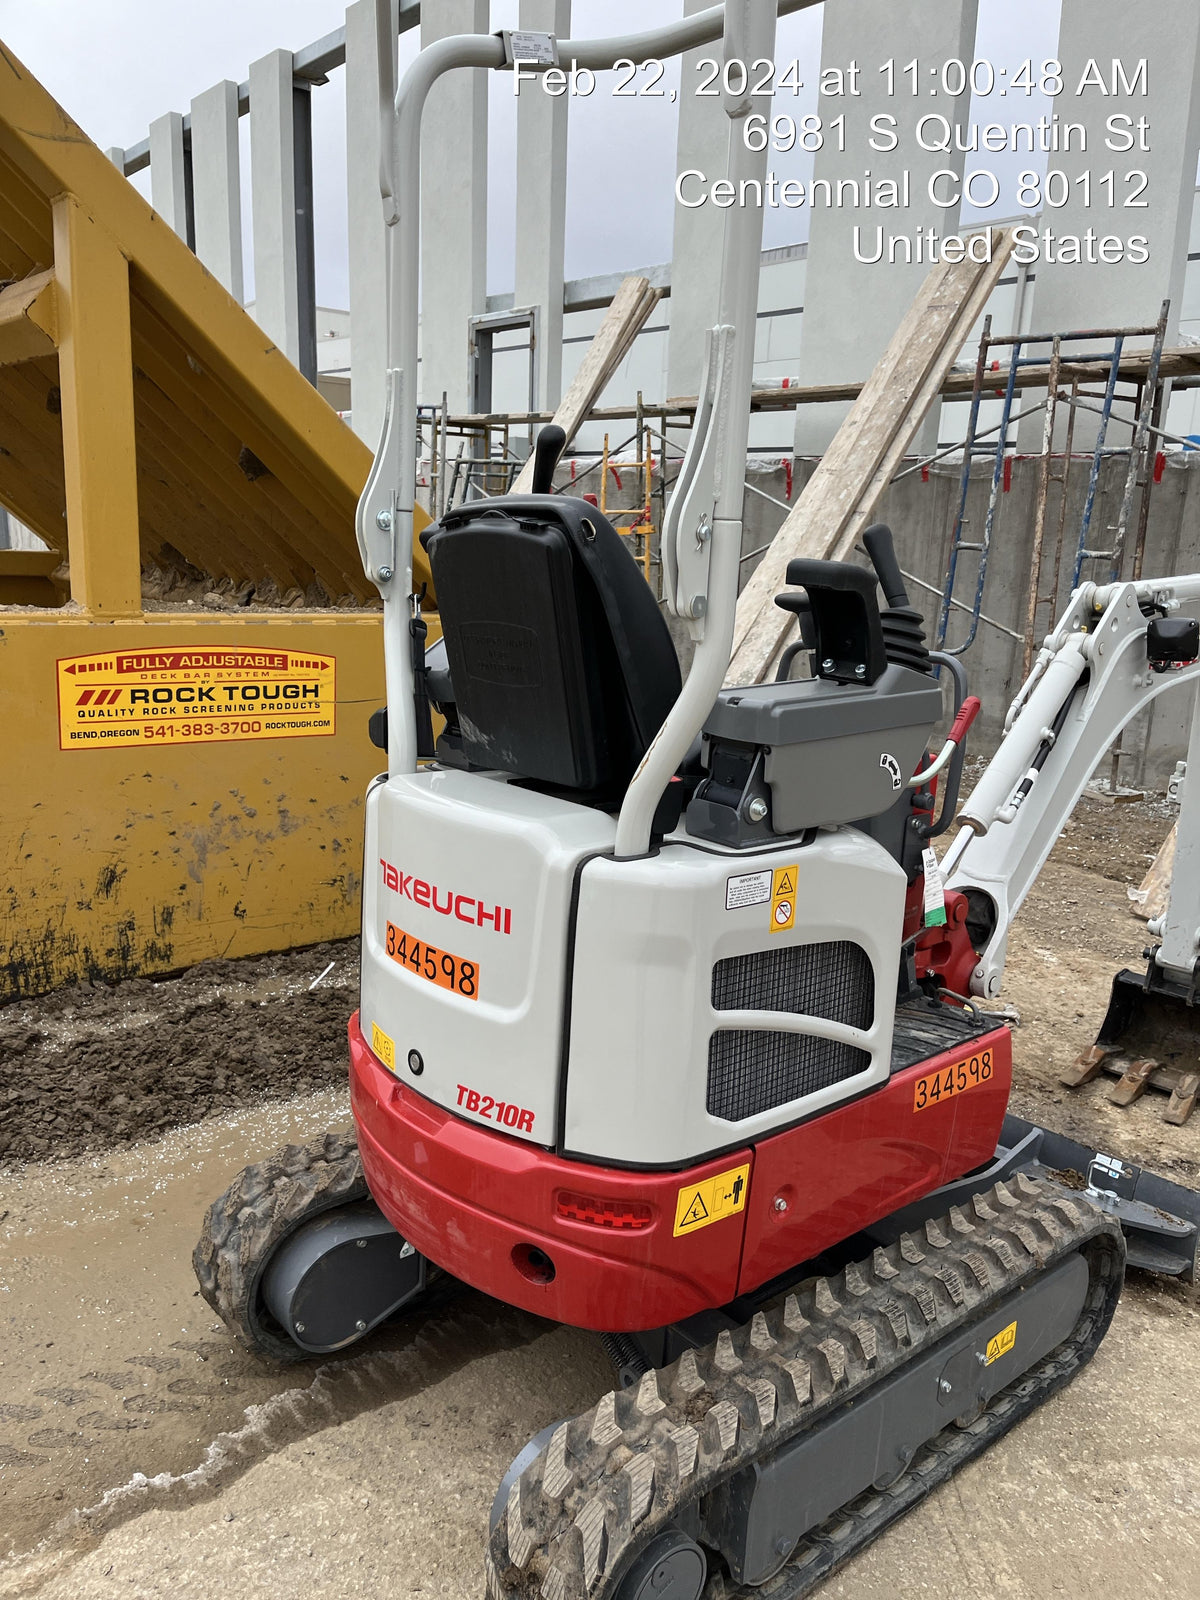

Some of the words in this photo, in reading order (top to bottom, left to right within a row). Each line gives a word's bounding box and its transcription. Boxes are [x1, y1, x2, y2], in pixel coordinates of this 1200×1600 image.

[122, 656, 175, 670] FULLY
[179, 655, 284, 668] ADJUSTABLE
[130, 687, 217, 704] ROCK
[222, 684, 319, 701] TOUGH
[77, 708, 136, 718] QUALITY
[142, 706, 177, 716] ROCK
[184, 703, 255, 714] SCREENING
[261, 701, 321, 711] PRODUCTS
[70, 728, 140, 740] BEND,OREGON
[143, 720, 262, 739] 541-383-3700
[265, 719, 331, 730] ROCKTOUGH.COM
[386, 923, 476, 997] 344598
[916, 1051, 992, 1109] 344598
[456, 1083, 536, 1133] TB210R
